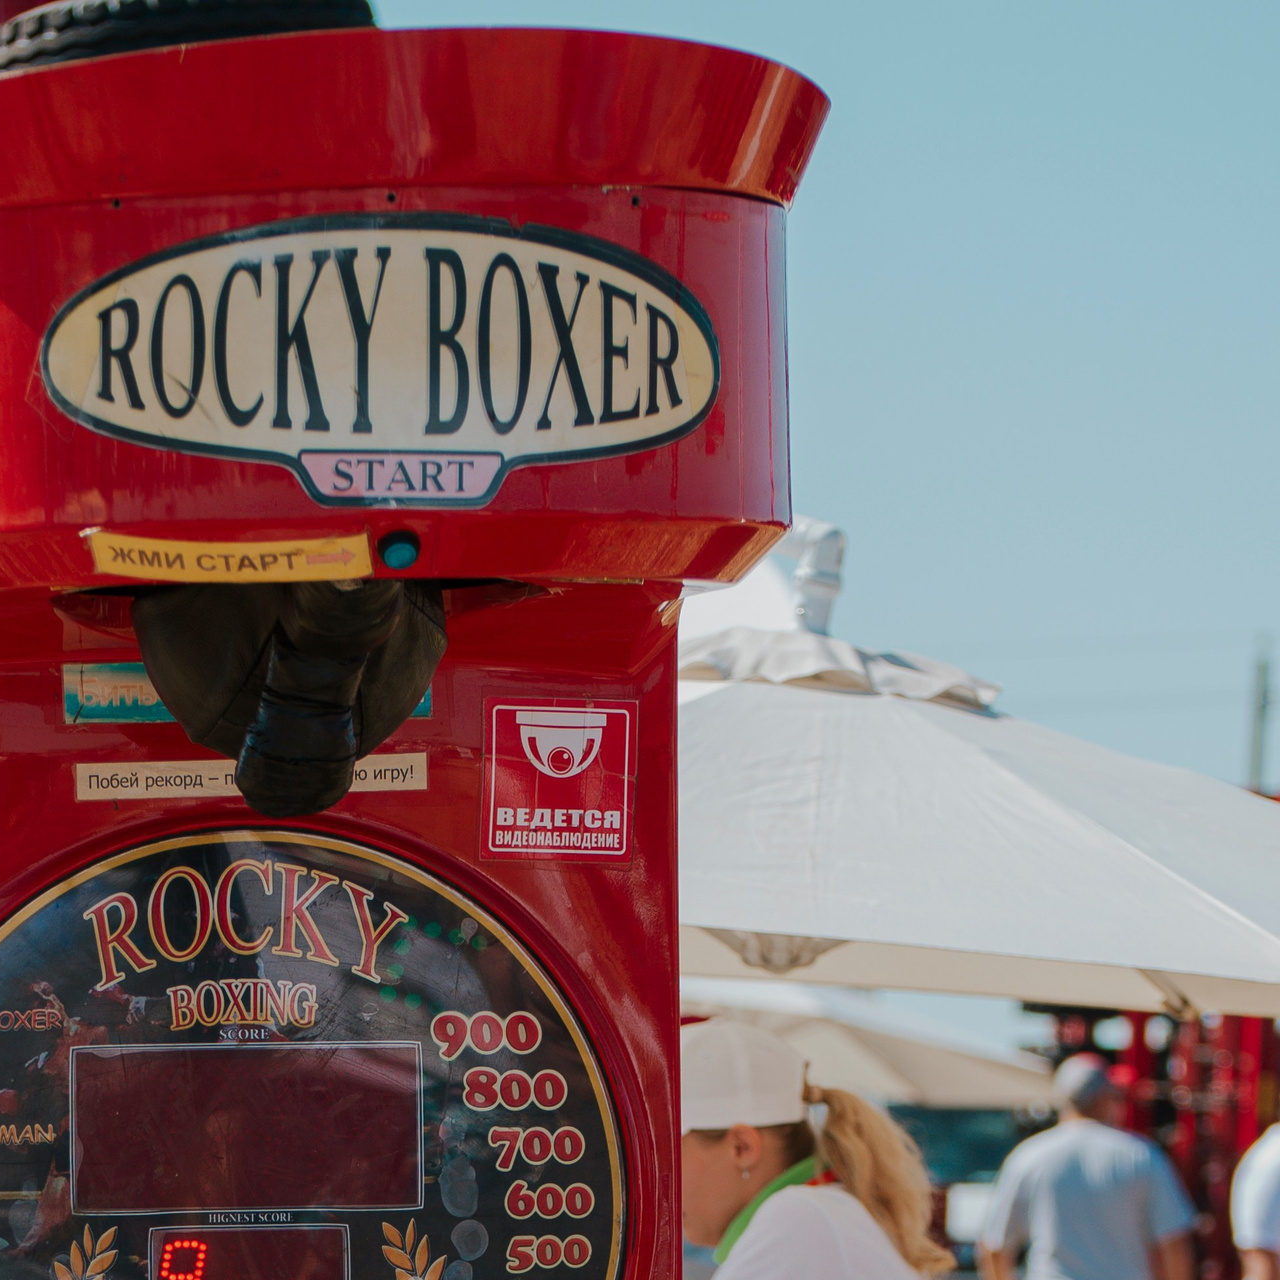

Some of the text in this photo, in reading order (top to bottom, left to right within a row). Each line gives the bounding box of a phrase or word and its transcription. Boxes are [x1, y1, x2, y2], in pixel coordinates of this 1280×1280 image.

[97, 247, 683, 435] ROCKY BOXER
[332, 459, 474, 494] START
[111, 547, 297, 573] ЖМИ СТАРТ
[88, 773, 138, 790] Побей
[145, 776, 203, 792] рекорд
[373, 765, 413, 784] игру!
[497, 807, 620, 829] ВЕДЕТСЯ
[495, 830, 620, 849] ВИДЕОНАБЛЮДЕНИЕ
[83, 858, 409, 991] ROCKY
[167, 979, 318, 1030] BOXING
[219, 1028, 270, 1040] SCORE
[430, 1010, 542, 1061] 900
[463, 1066, 567, 1111] 800
[488, 1125, 585, 1172] 700
[258, 1212, 293, 1222] SCORE
[504, 1180, 595, 1220] 600
[506, 1234, 592, 1274] 500
